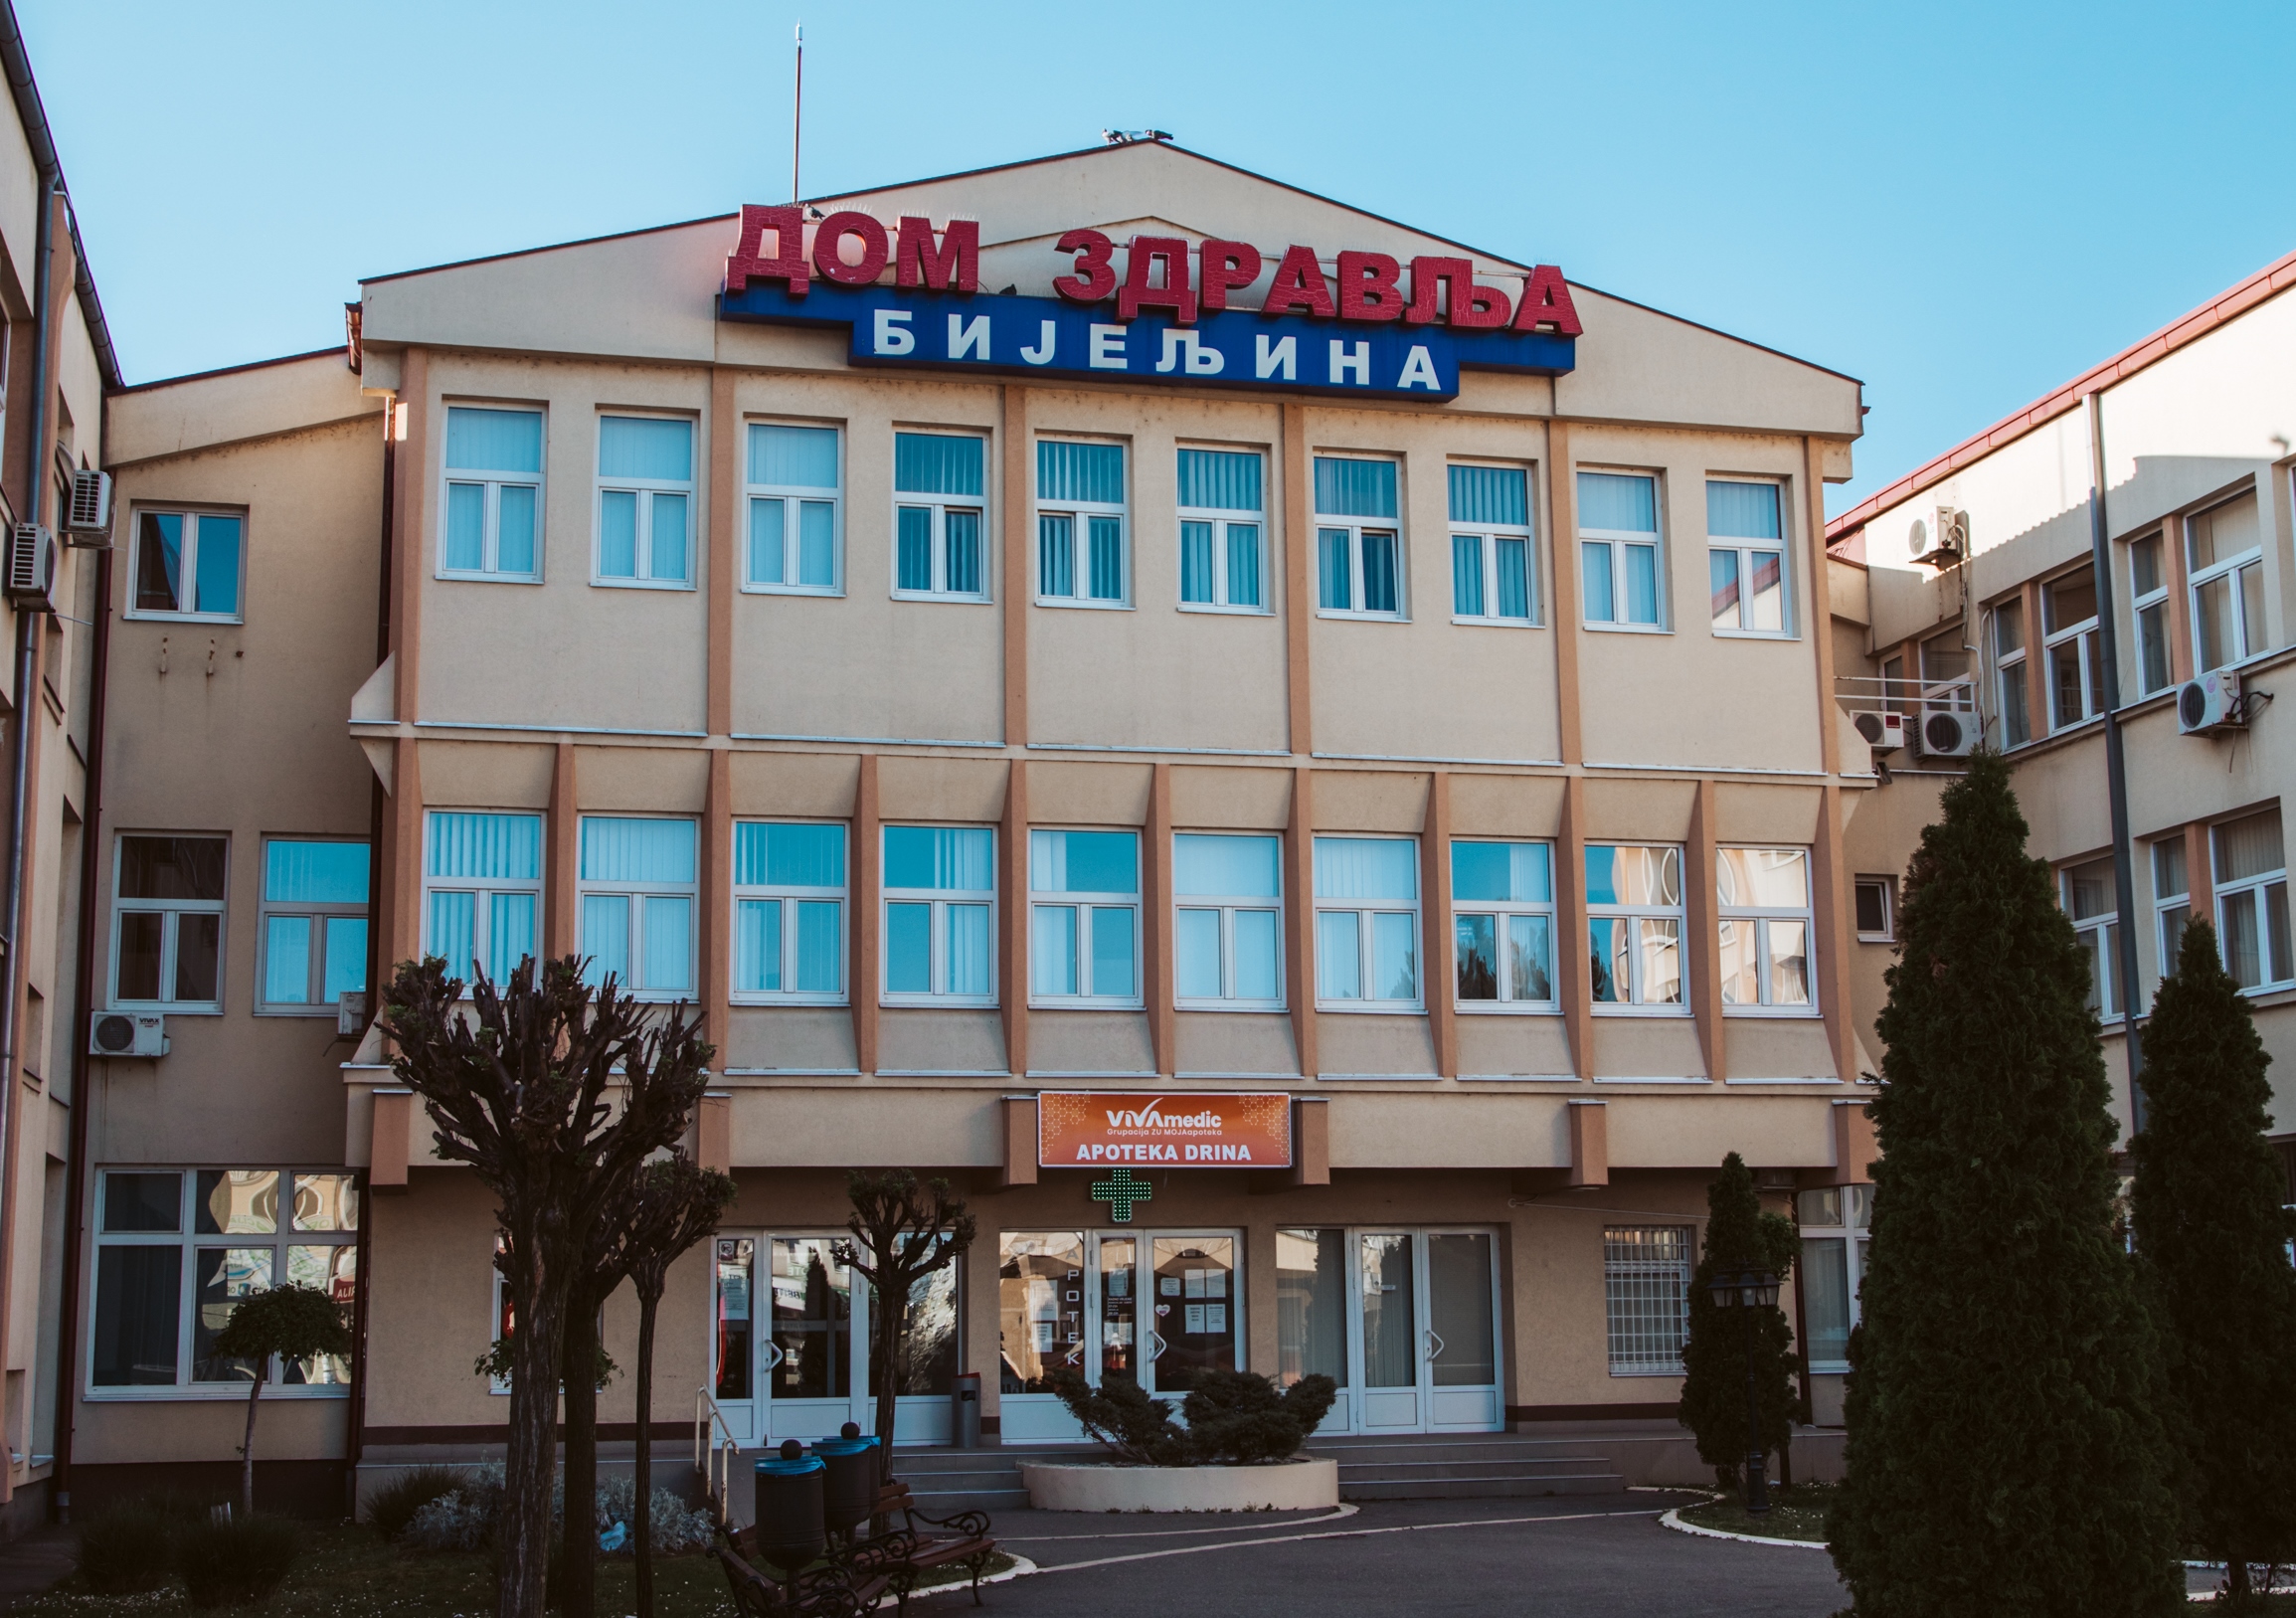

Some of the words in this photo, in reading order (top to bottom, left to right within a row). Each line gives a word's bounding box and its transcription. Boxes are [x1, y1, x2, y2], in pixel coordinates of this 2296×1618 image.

[725, 203, 979, 296] ДОМ
[1052, 228, 1583, 337] ЗДРАВЉА
[873, 308, 1442, 391] БИЈЕЉИНА
[1076, 1144, 1178, 1161] APOTEKA
[1184, 1144, 1252, 1161] DRINA
[1107, 1128, 1149, 1137] Grupacija
[1163, 1128, 1222, 1137] MOJAapoteka
